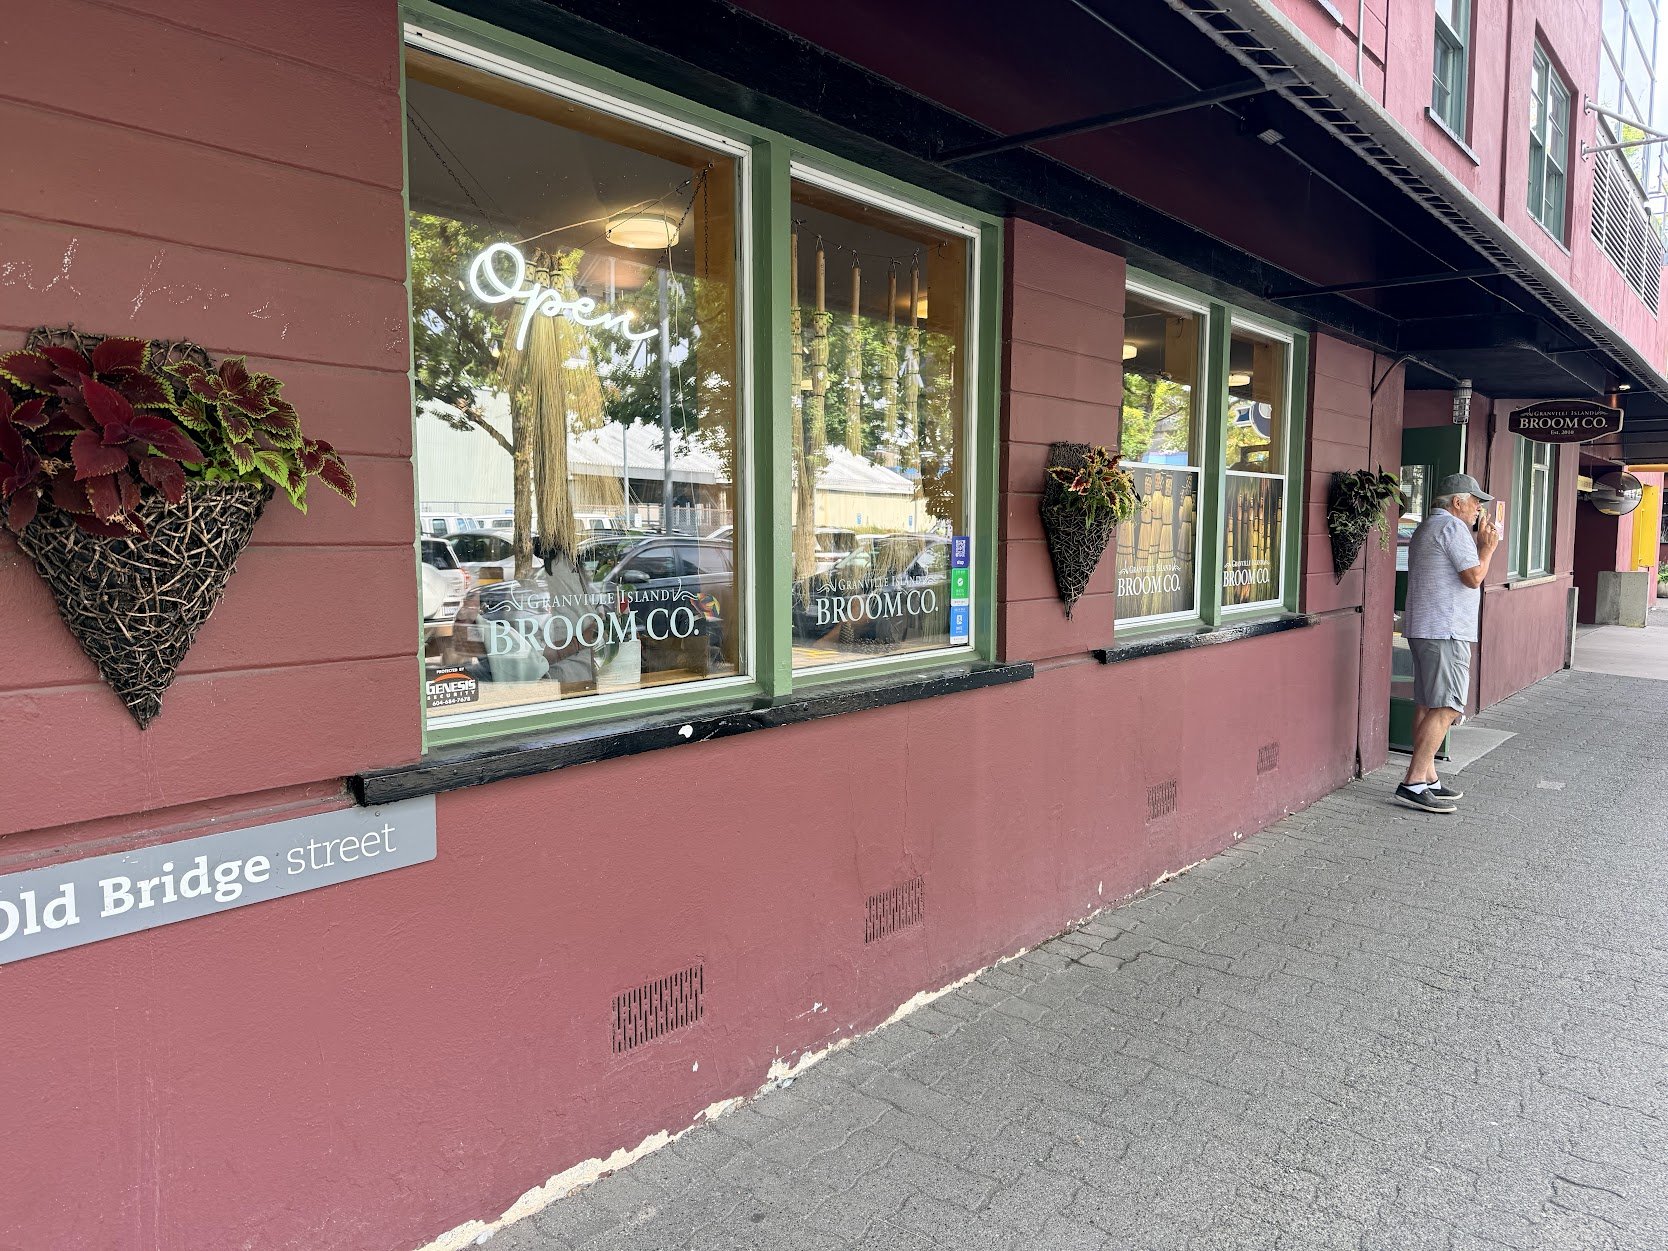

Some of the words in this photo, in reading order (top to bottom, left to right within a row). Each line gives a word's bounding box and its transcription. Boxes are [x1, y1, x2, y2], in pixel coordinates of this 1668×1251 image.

[469, 242, 659, 350] Open
[1519, 417, 1579, 429] BROOM
[1582, 417, 1608, 429] CO.
[1118, 576, 1162, 597] BROOM
[1163, 574, 1180, 592] CO.
[1223, 569, 1255, 587] BROOM
[1257, 567, 1270, 583] CO.
[527, 592, 616, 610] GRANVILLE
[620, 588, 670, 605] ISLAND
[815, 591, 903, 625] BROOM
[907, 588, 939, 615] CO.
[488, 609, 641, 656] BROOM
[646, 606, 700, 641] CO.
[426, 680, 476, 695] GENESIS
[427, 690, 476, 700] SECURITY
[99, 854, 270, 917] Bridge
[286, 822, 397, 876] street
